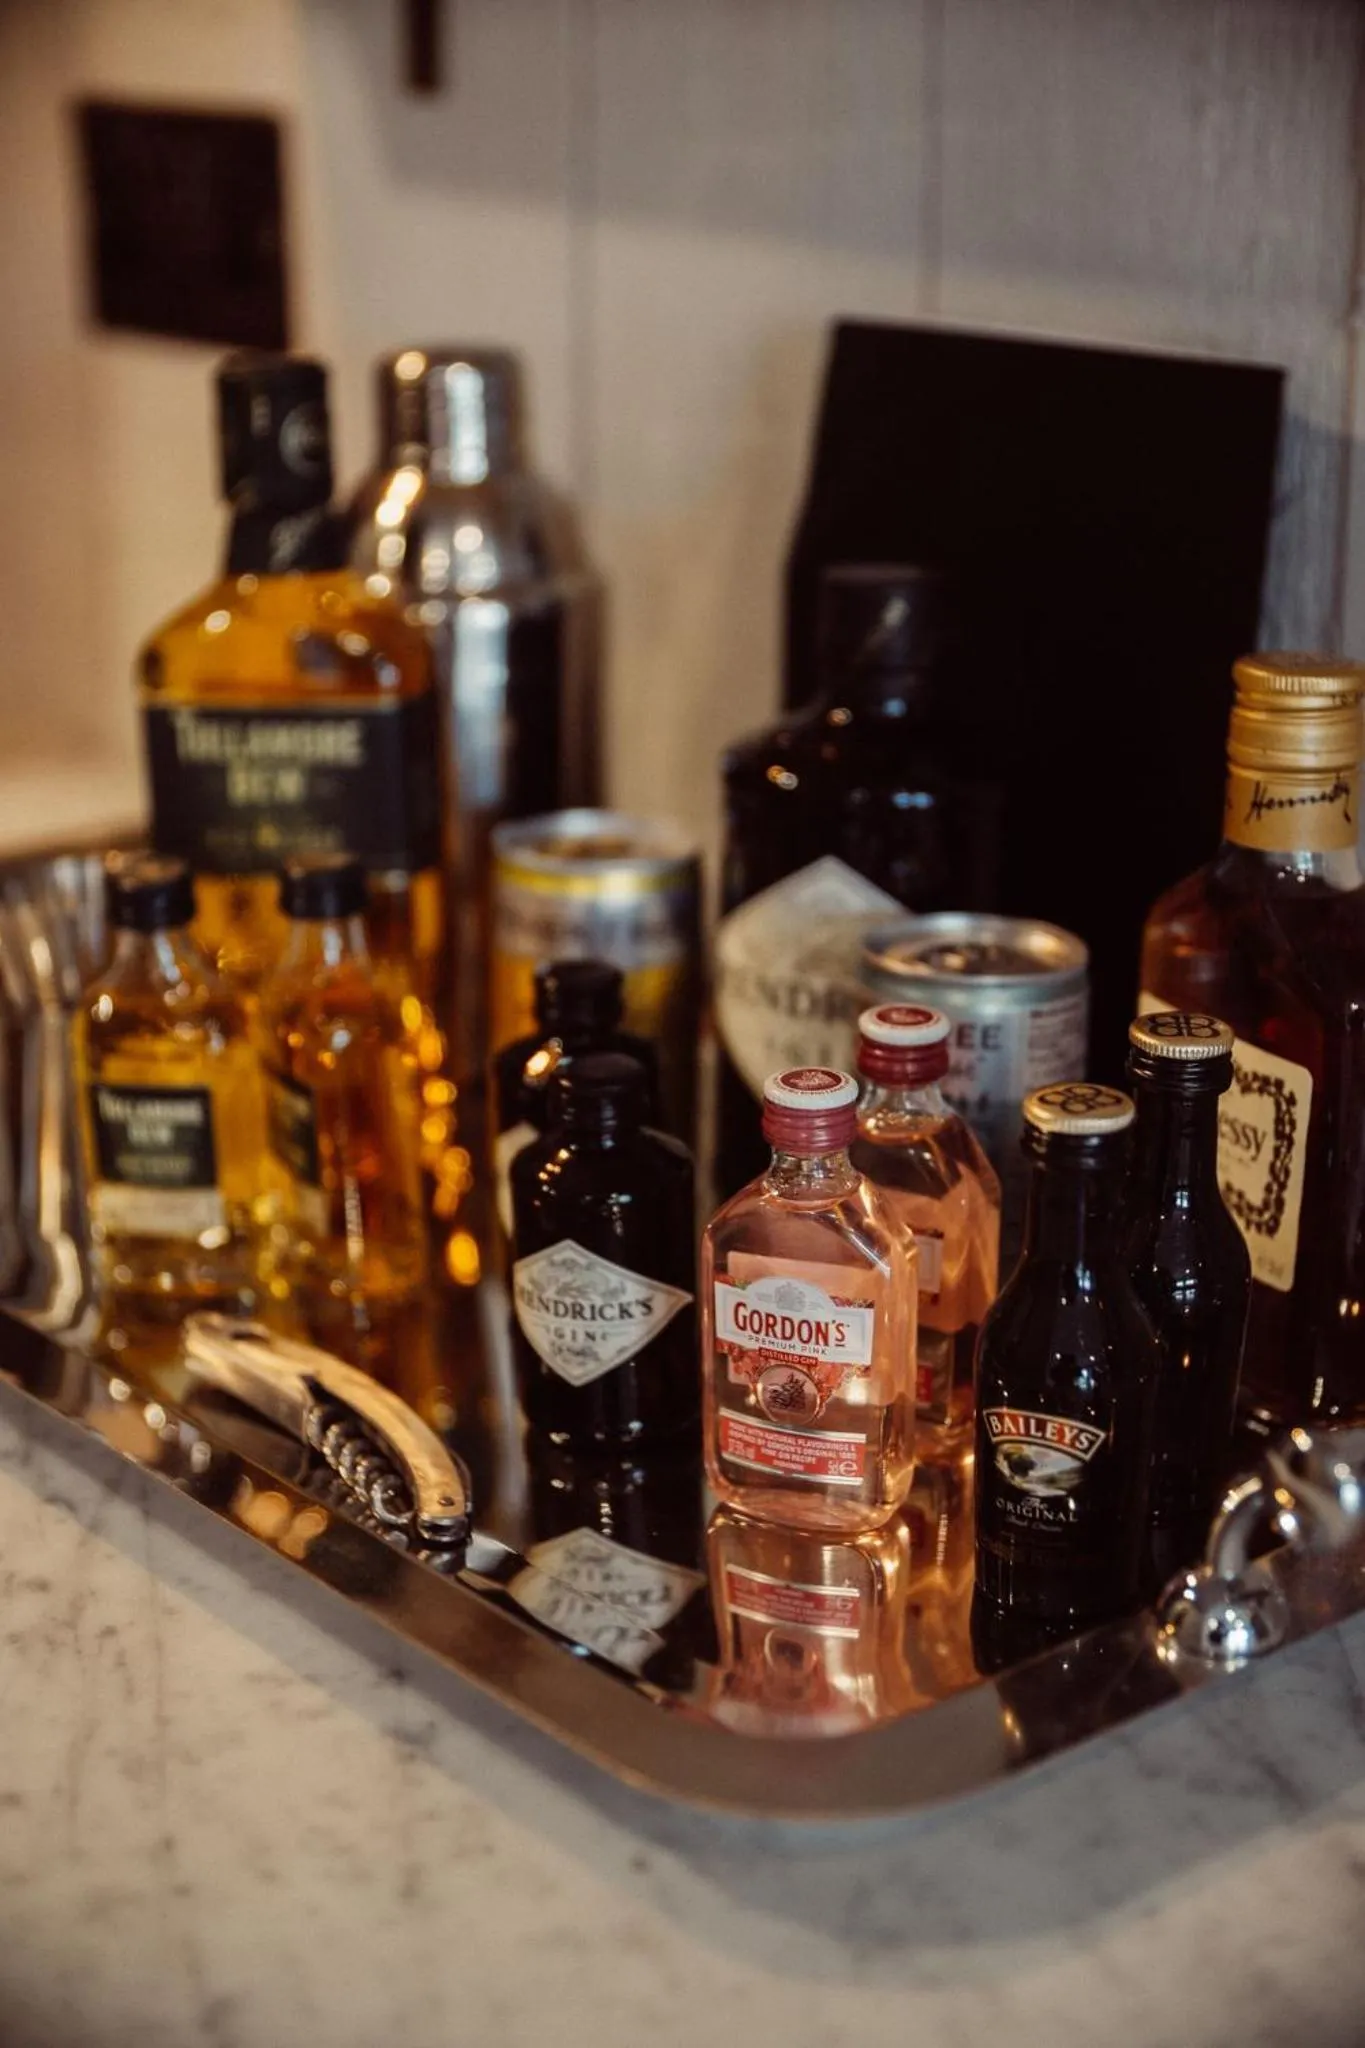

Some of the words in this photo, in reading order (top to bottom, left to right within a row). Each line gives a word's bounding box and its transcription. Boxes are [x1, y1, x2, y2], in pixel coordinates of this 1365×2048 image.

[955, 1023, 1003, 1049] EE
[554, 1328, 597, 1342] GIN
[734, 1301, 846, 1347] GORDON'S
[747, 1334, 796, 1350] PREMIUM
[801, 1346, 828, 1356] PINK
[989, 1415, 1093, 1450] BAILEYS
[996, 1498, 1078, 1523] ORIGINAL
